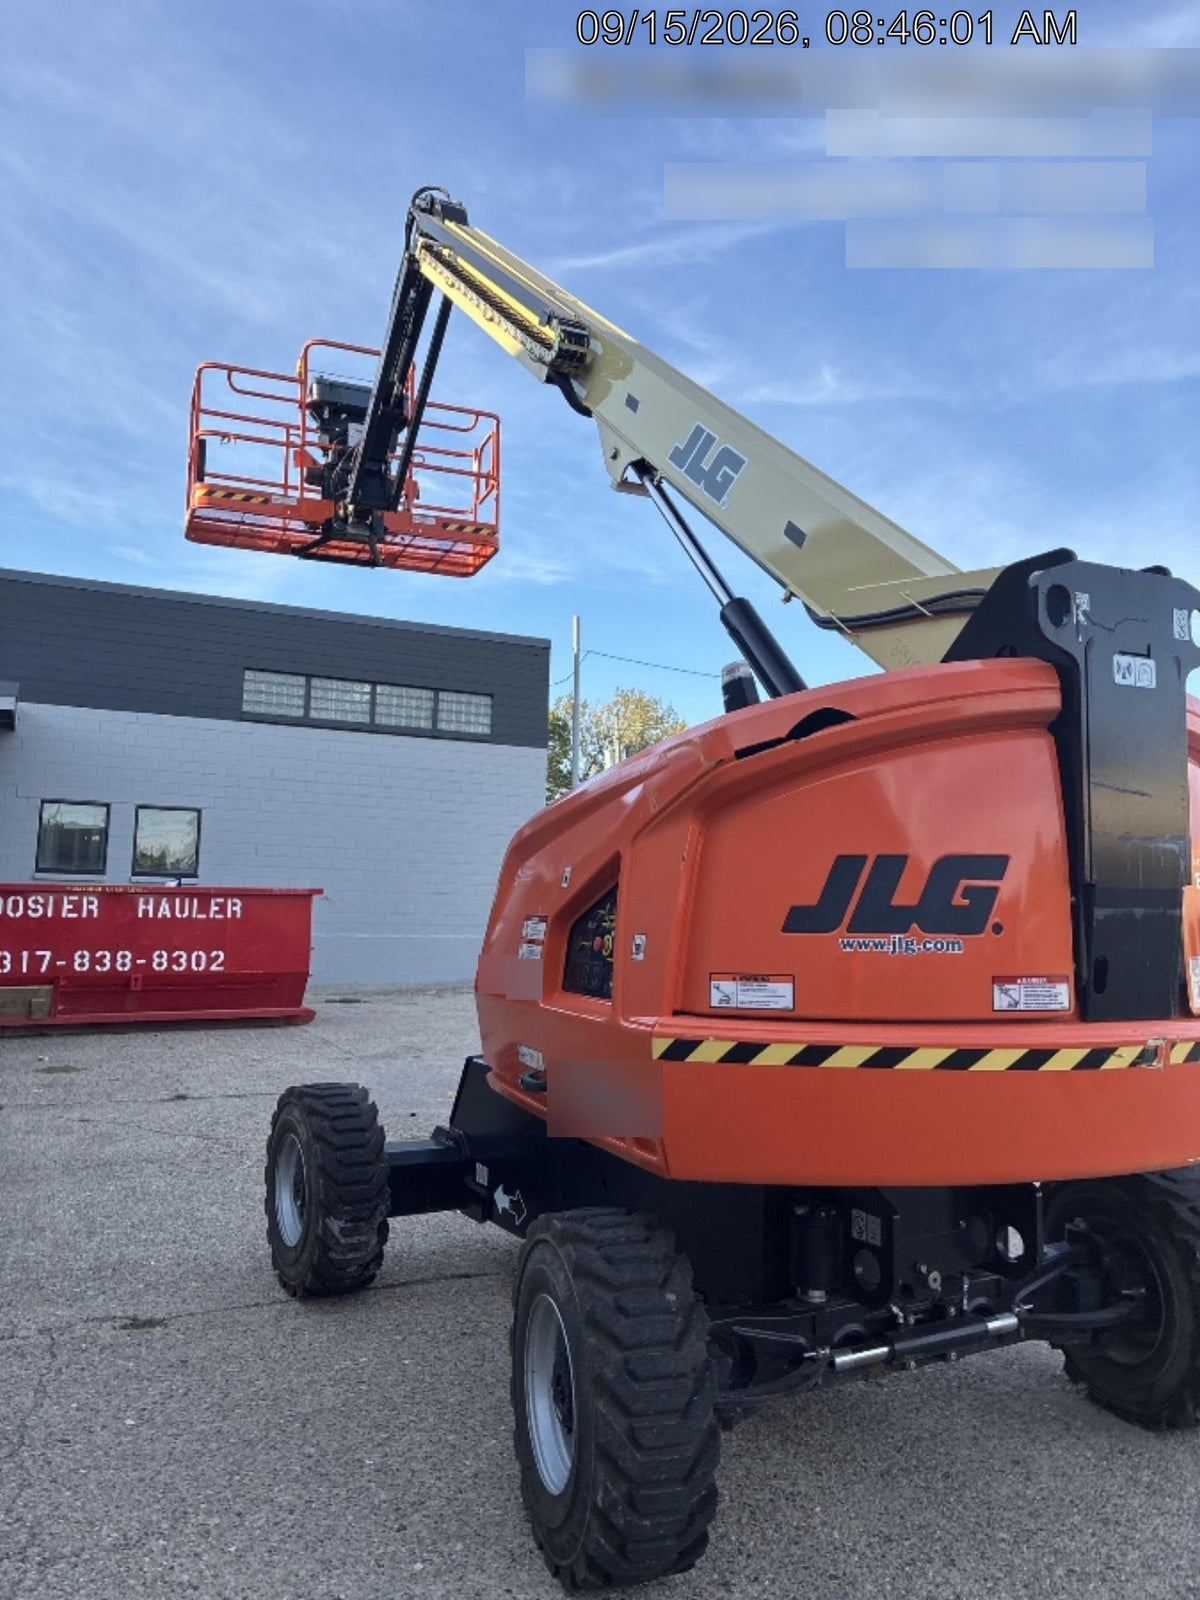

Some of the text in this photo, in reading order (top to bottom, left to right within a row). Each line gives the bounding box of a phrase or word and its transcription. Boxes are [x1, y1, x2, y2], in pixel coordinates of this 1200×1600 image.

[0, 895, 242, 918] OSIER HAULER
[838, 935, 964, 956] www.jlg.com
[0, 950, 225, 973] 317-838-8302
